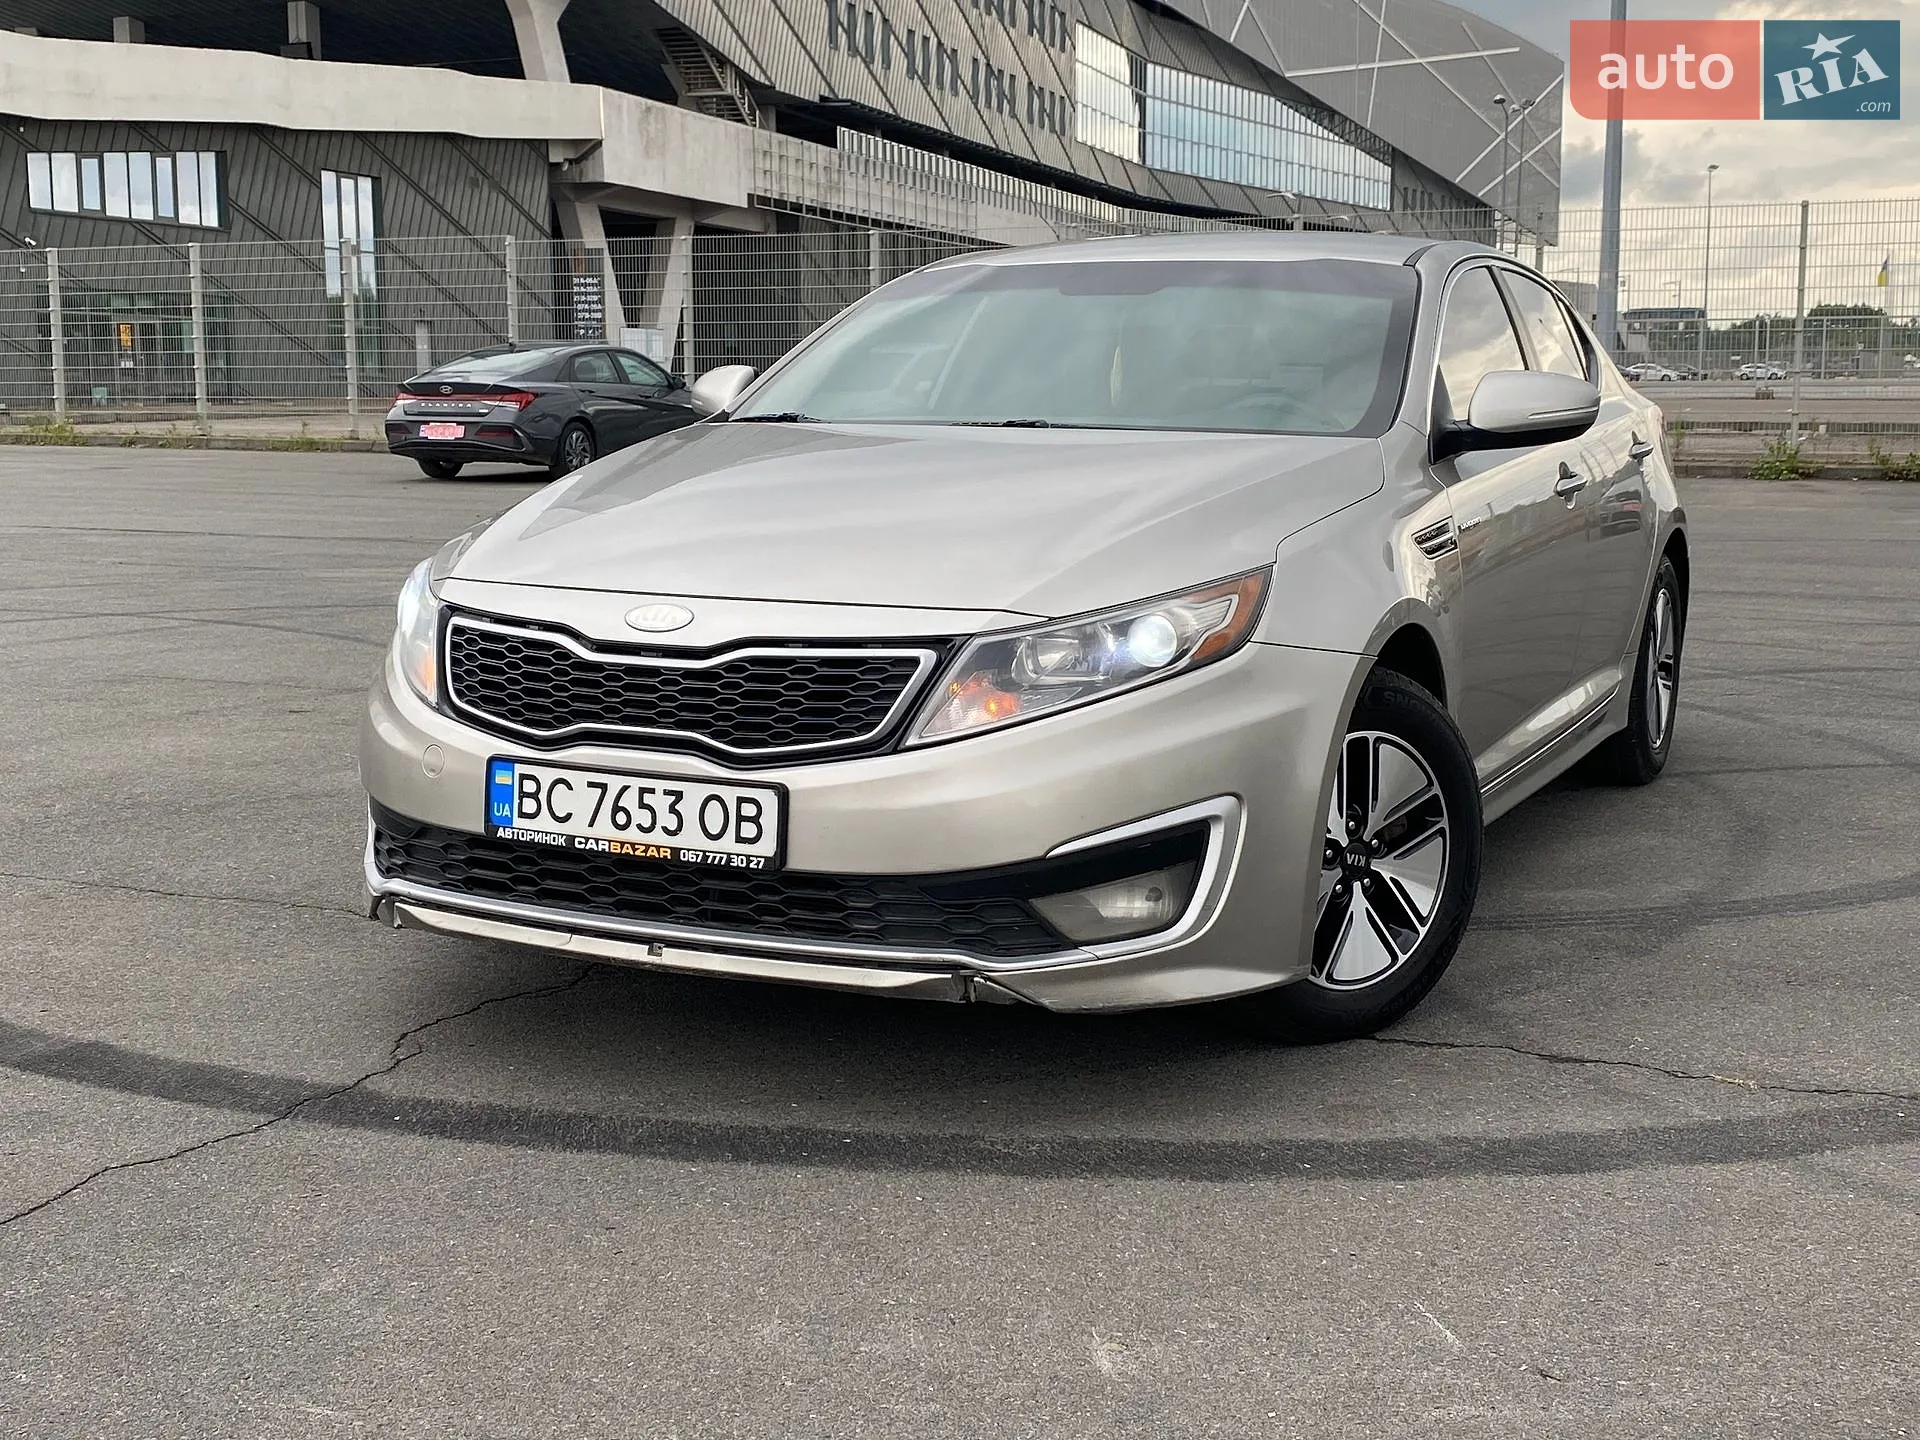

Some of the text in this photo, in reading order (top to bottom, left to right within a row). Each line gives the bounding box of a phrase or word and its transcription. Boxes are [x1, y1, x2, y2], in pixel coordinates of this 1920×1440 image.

[494, 802, 511, 818] UA
[517, 772, 574, 823] BC
[586, 780, 684, 837] 7653
[496, 826, 567, 847] АВТОРИНОК
[574, 836, 765, 870] CARBAZAR 067 777 30 27
[1346, 852, 1366, 867] KIA
